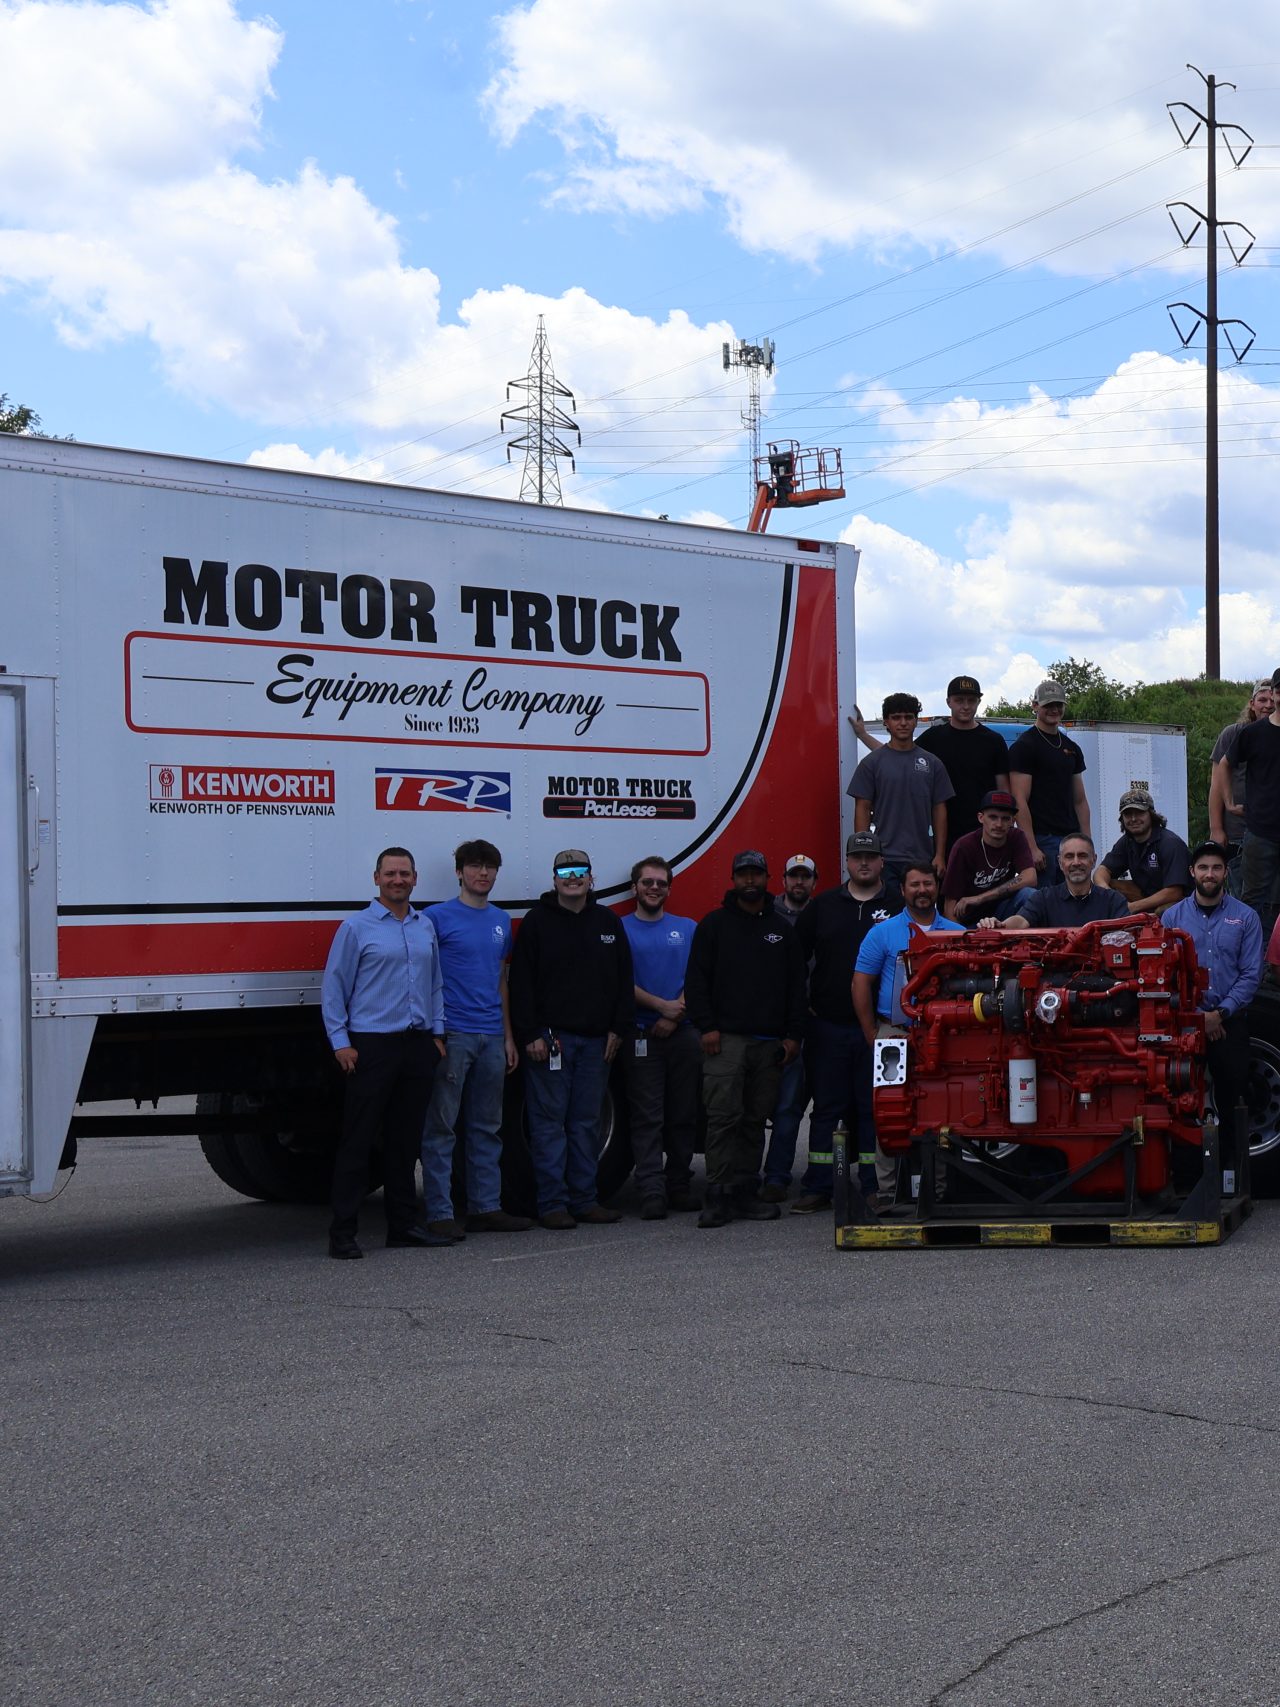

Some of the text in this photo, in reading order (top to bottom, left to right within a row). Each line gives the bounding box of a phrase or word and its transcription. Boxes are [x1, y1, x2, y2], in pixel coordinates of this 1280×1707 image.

[163, 556, 682, 663] MOTOR TRUCK
[265, 653, 605, 736] Equipment Company
[404, 713, 480, 735] Since 1933
[187, 771, 331, 798] KENWORTH
[375, 772, 511, 815] TRP
[547, 775, 692, 799] MOTOR TRUCK
[149, 802, 335, 817] KENWORTH OF PENNSYLVANIA
[583, 800, 657, 818] PacLease
